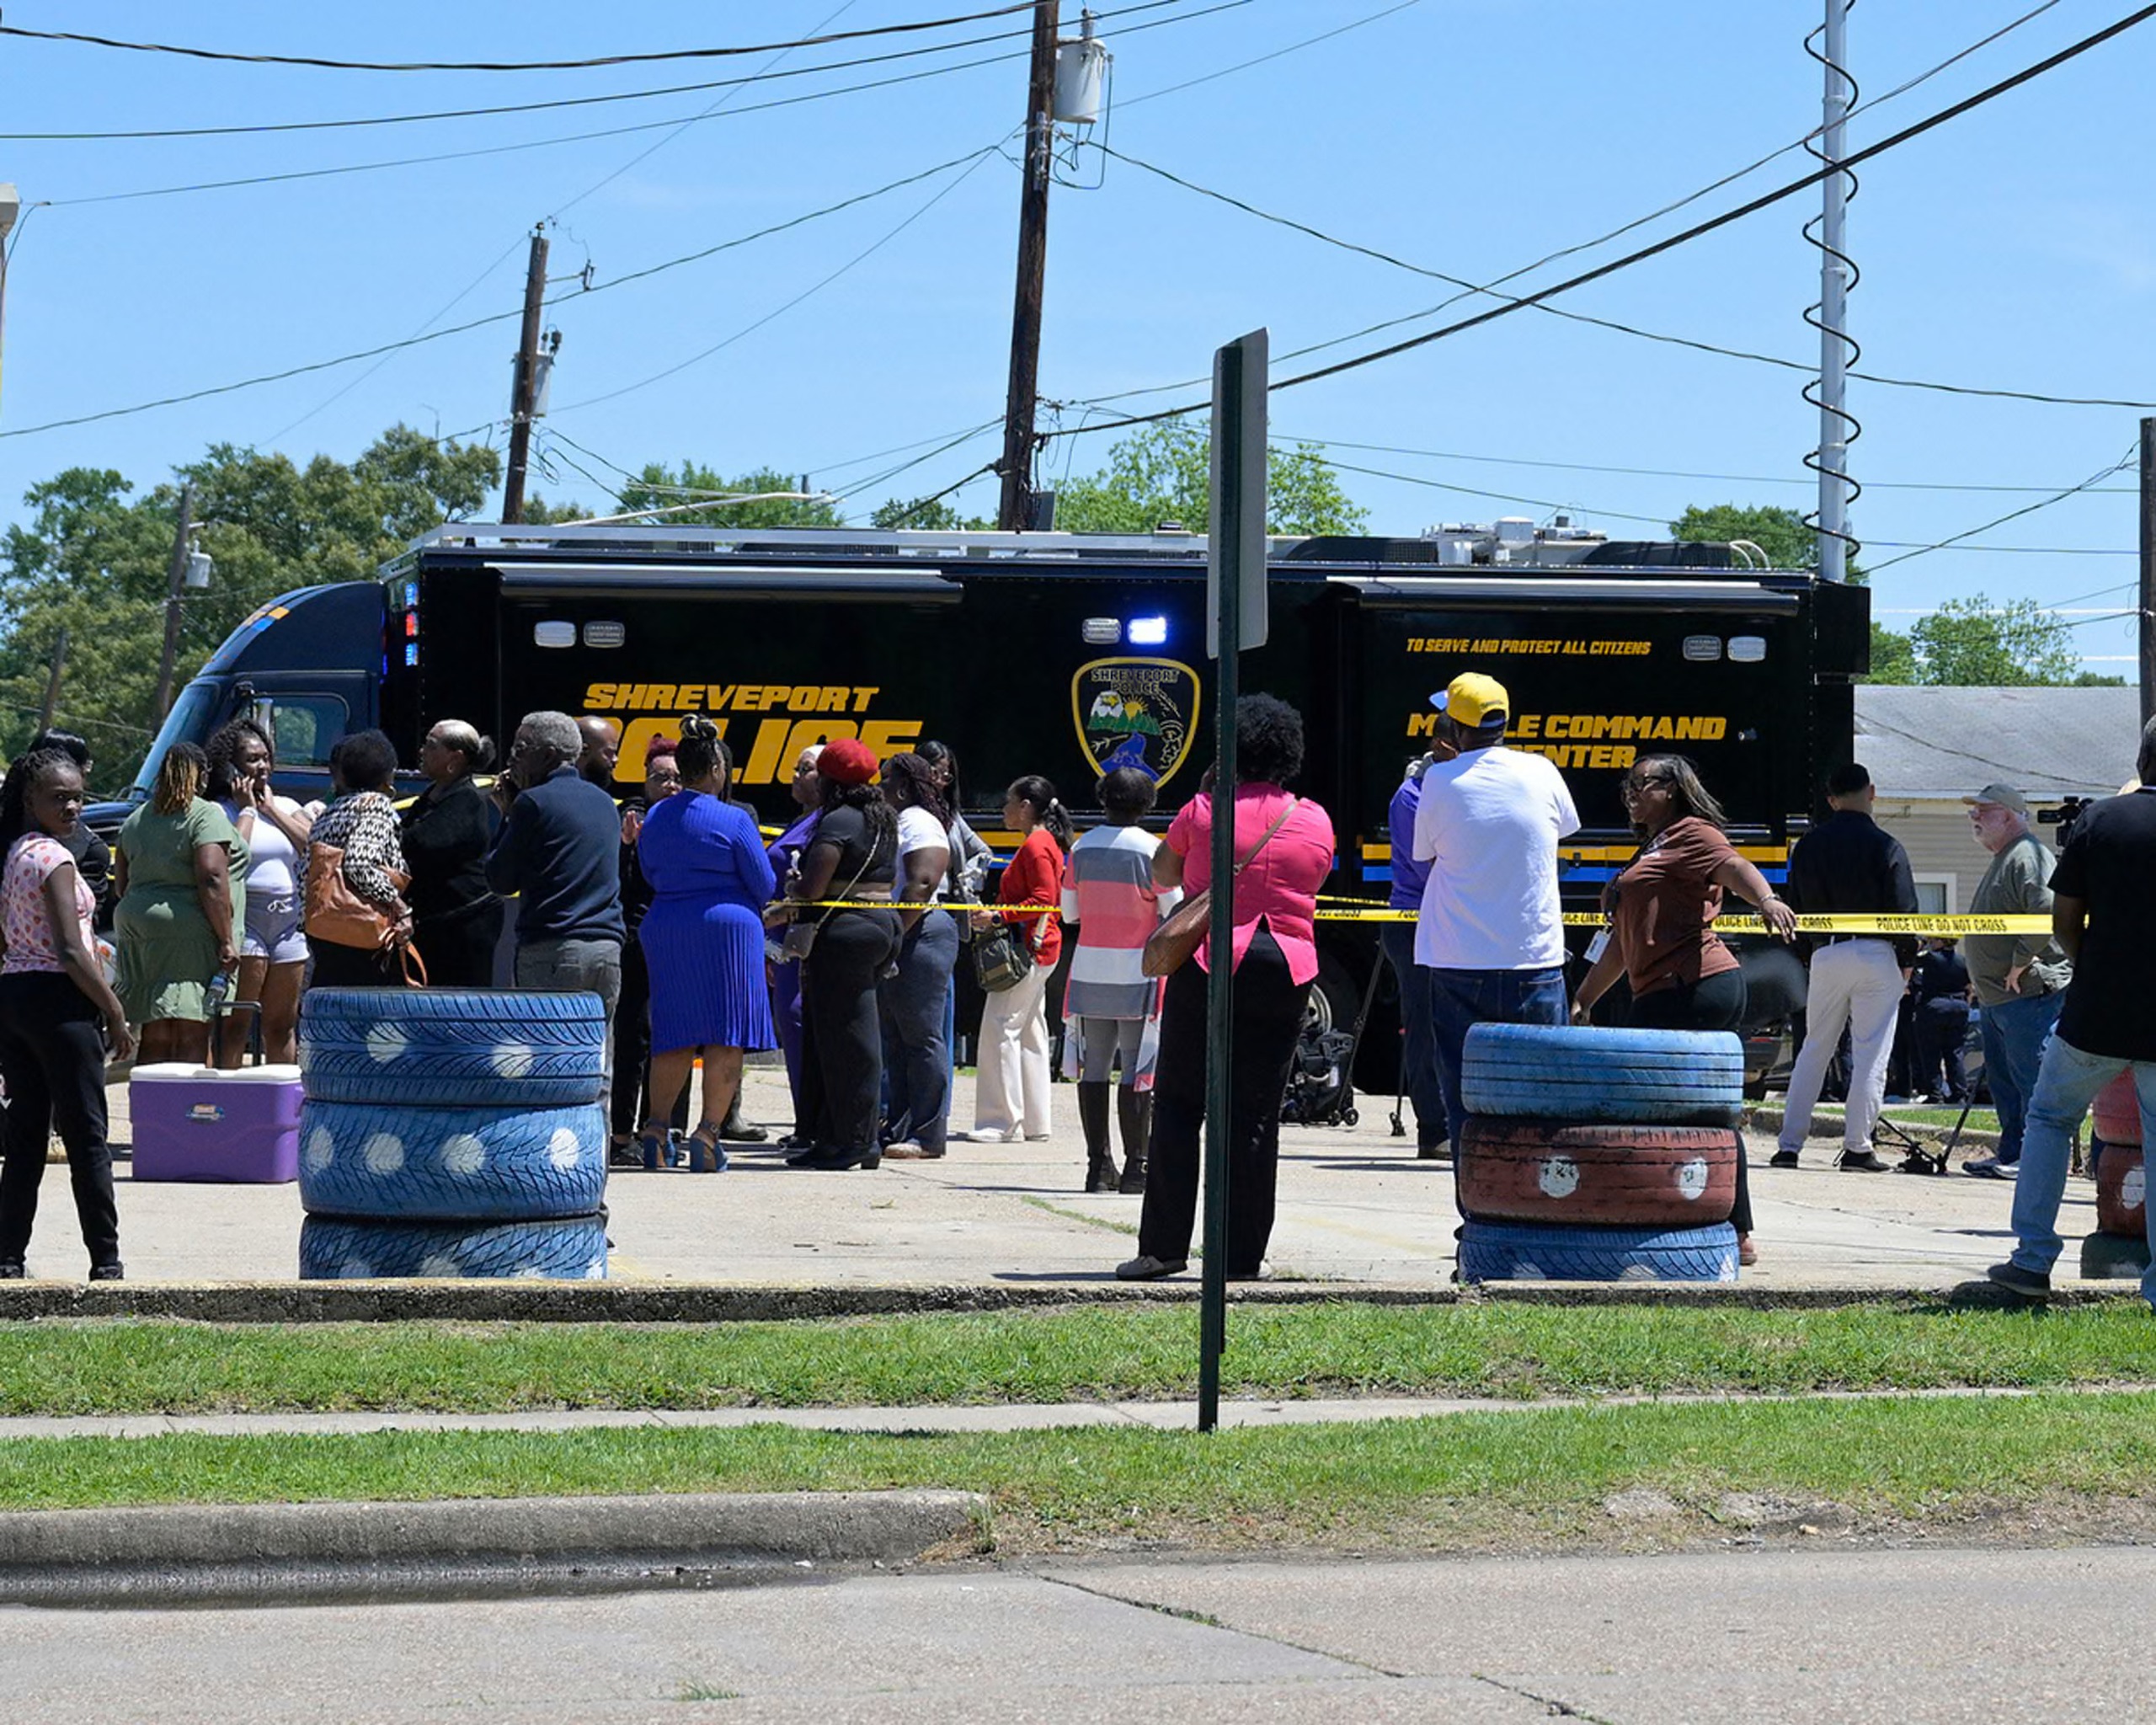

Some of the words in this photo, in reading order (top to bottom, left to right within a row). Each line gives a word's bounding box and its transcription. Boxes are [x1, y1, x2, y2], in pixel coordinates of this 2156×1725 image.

[1406, 638, 1424, 652] TO
[1425, 638, 1469, 653] SERVE
[1470, 639, 1498, 654] AND
[1500, 639, 1561, 654] PROTECT
[1562, 640, 1587, 654] ALL
[1589, 641, 1652, 655] CITIZENS
[1091, 668, 1181, 684] SHREVEPORT
[1111, 681, 1159, 695] POLICE
[584, 683, 880, 713] SHREVEPORT
[1545, 714, 1726, 740] COMMAND
[574, 716, 923, 785] OICE
[1801, 916, 1833, 929] CROSS
[1876, 917, 1909, 931] POLICE
[1912, 917, 1934, 932] LINE
[1936, 918, 1951, 932] DO
[1953, 919, 1972, 932] NOT
[1974, 919, 2007, 932] CROSS
